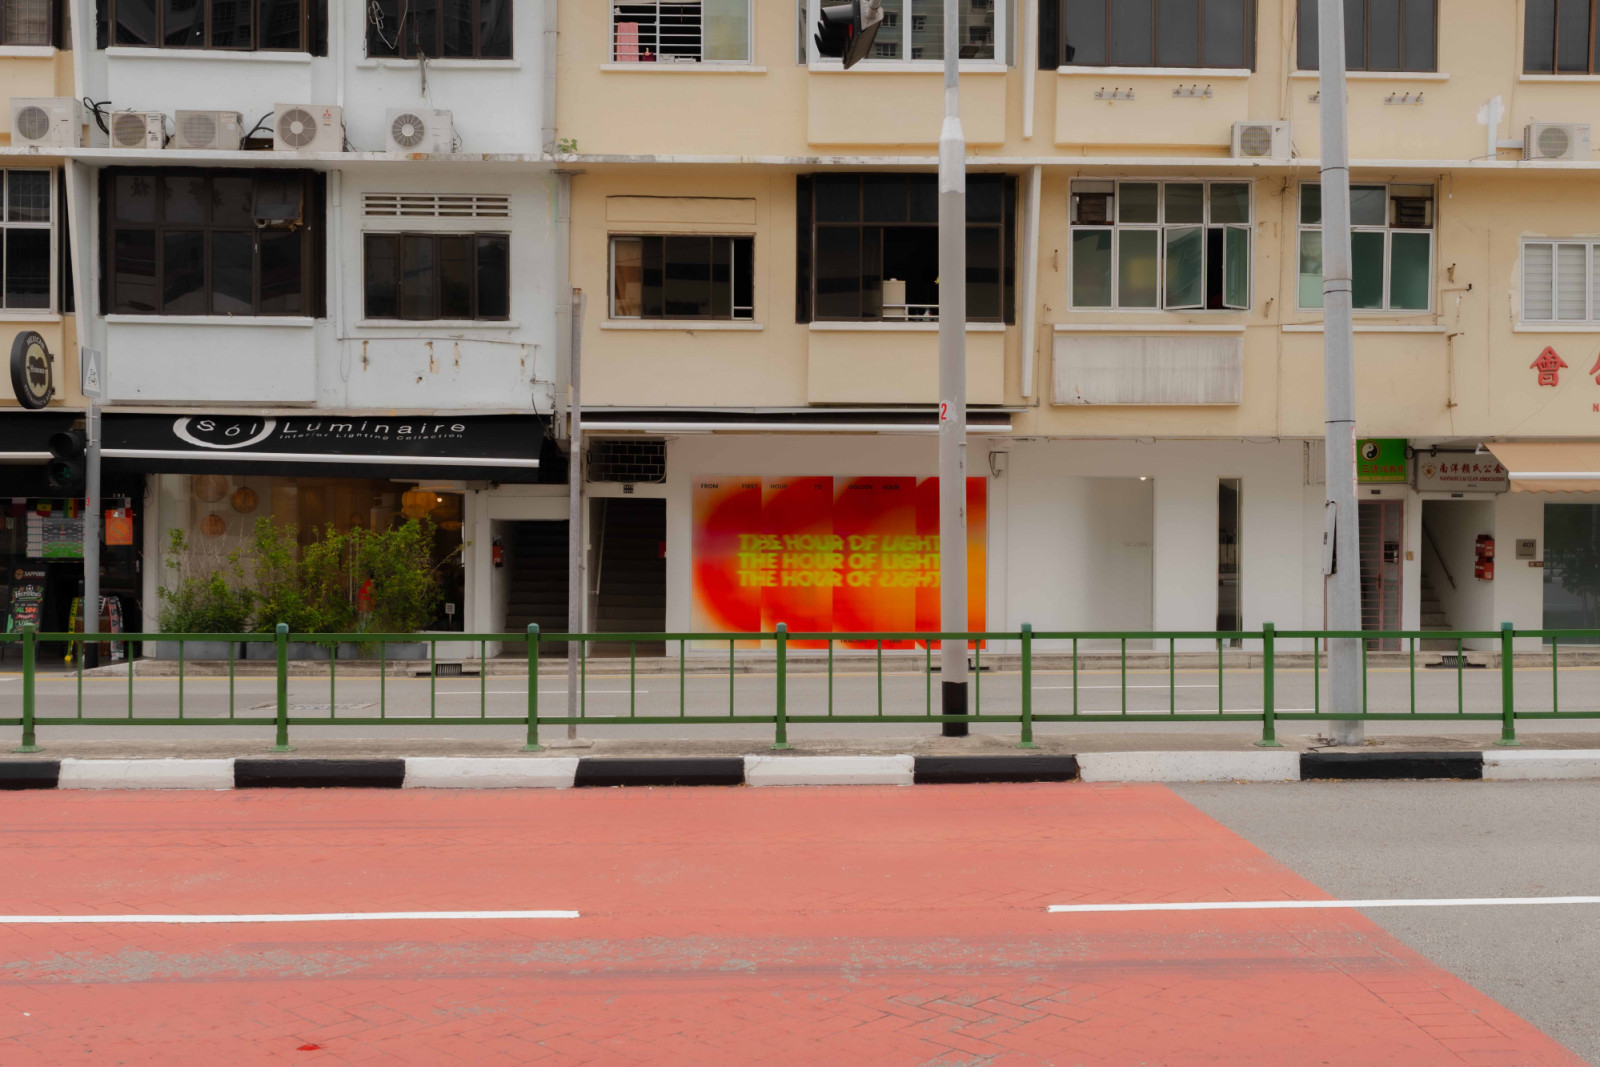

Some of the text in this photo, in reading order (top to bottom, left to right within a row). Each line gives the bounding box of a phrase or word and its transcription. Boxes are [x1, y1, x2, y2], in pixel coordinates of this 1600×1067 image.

[940, 402, 948, 420] 2
[282, 420, 466, 434] Luminaire
[279, 432, 464, 441] Interior Lighting Collection
[737, 552, 778, 569] THE
[782, 552, 844, 569] HOUR
[848, 553, 878, 570] OF
[737, 570, 778, 587] THE
[781, 570, 843, 587] HOUR
[846, 570, 877, 588] OF
